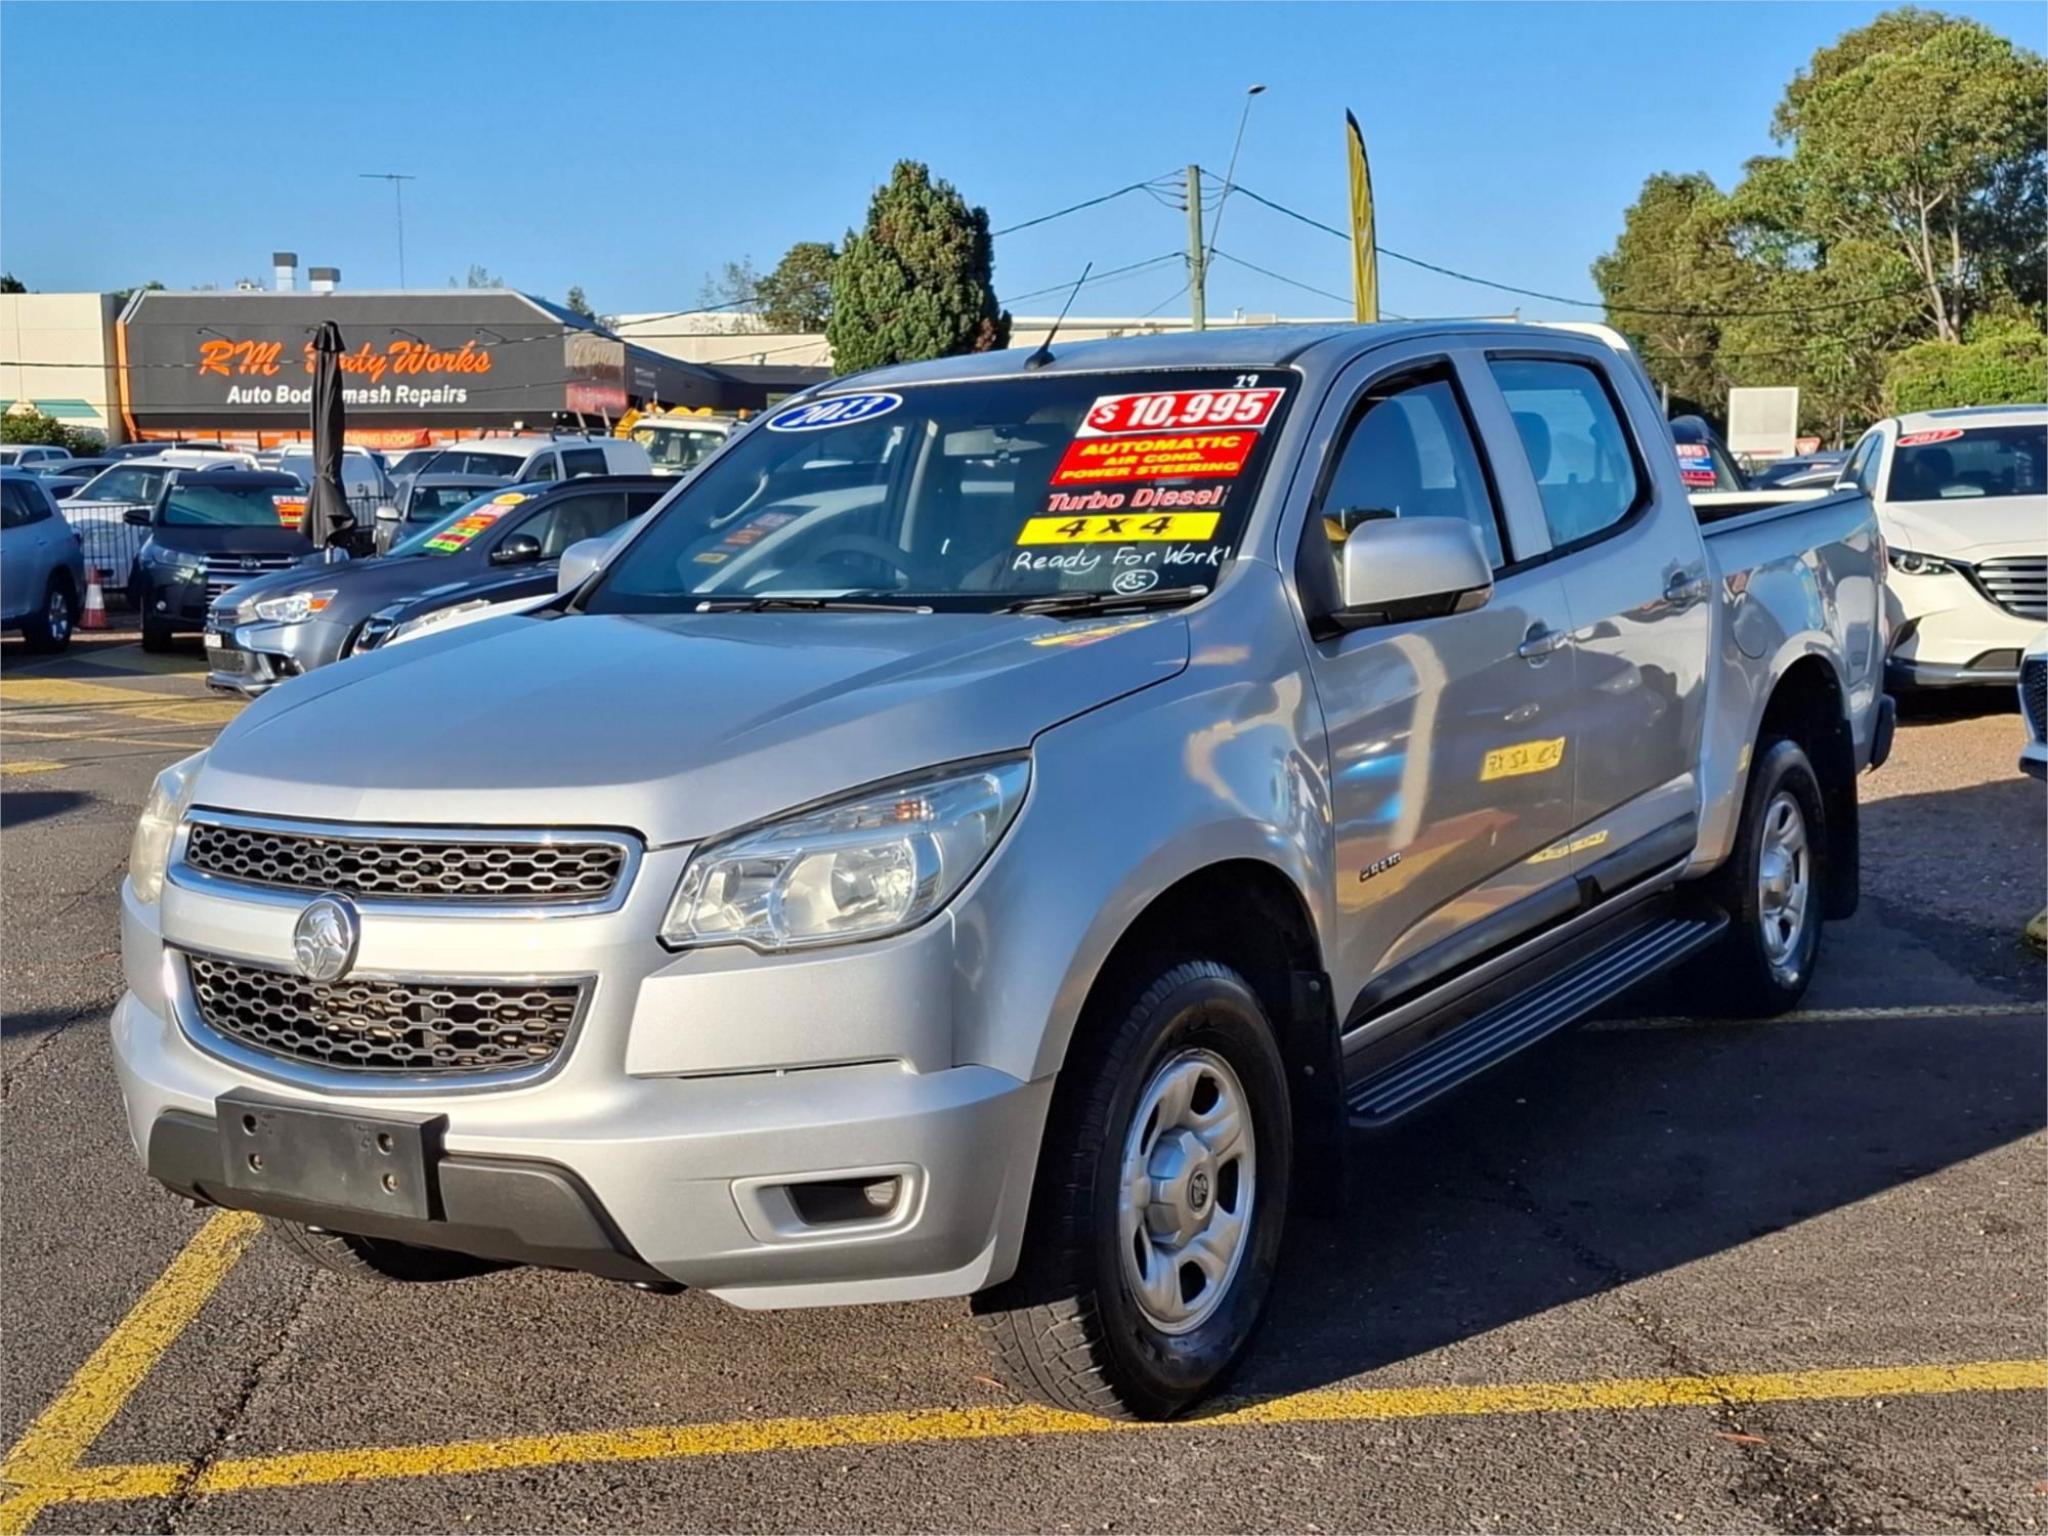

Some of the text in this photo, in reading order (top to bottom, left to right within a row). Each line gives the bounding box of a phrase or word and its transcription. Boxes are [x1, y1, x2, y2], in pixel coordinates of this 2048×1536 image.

[199, 340, 281, 376] RM
[227, 385, 467, 407] Auto Bod mash Repairs
[780, 397, 885, 426] 2013
[1126, 393, 1270, 427] 10,995
[1079, 436, 1241, 456] AUTOMATIC
[1060, 462, 1240, 480] POWER STEERING
[1103, 452, 1205, 466] AIR COND.
[1047, 485, 1224, 512] Turbo Diesel
[1055, 518, 1089, 538] 4
[1139, 516, 1174, 535] 4
[1012, 549, 1102, 575] Ready
[1112, 547, 1156, 566] For
